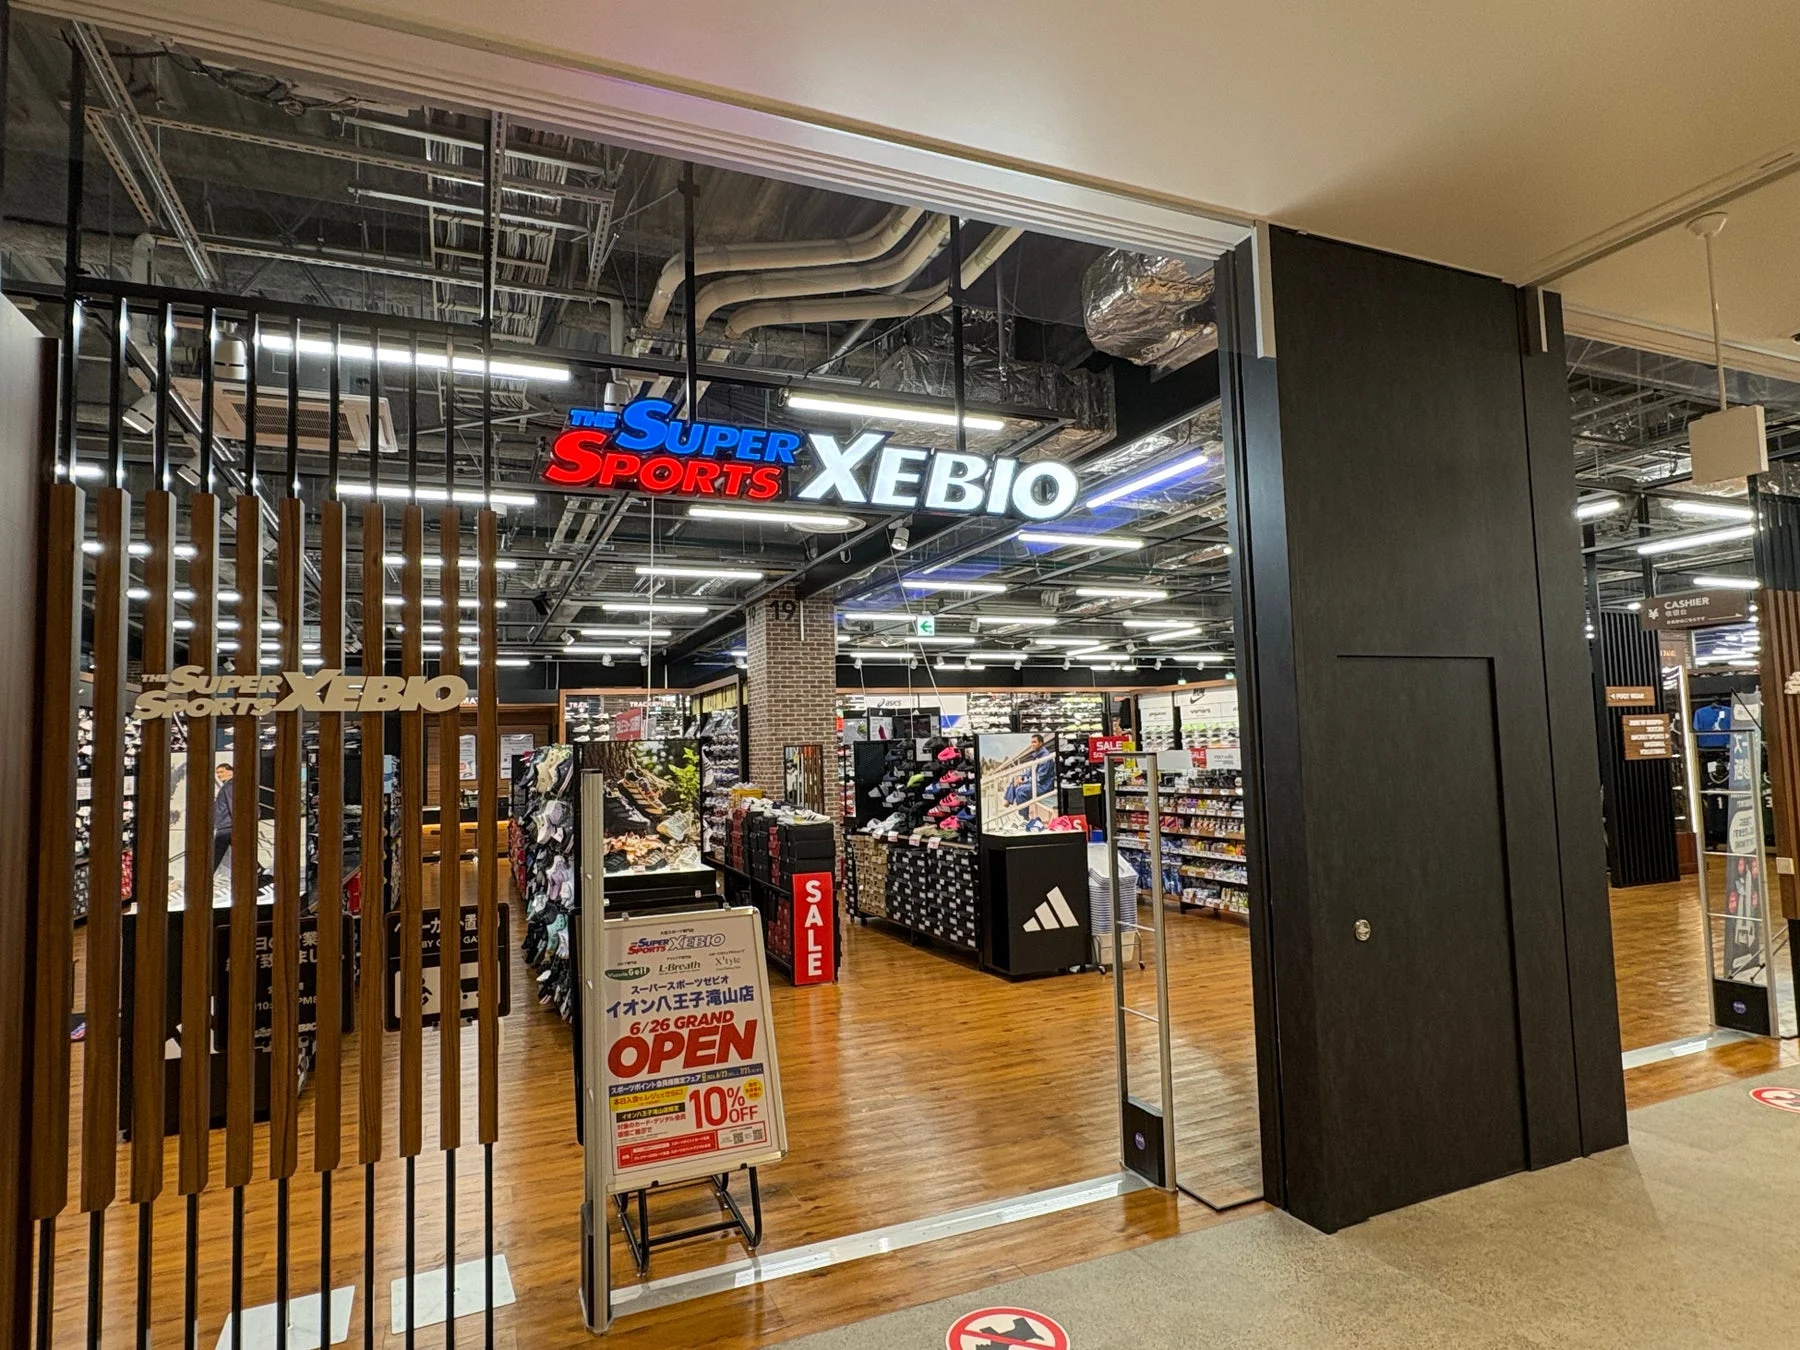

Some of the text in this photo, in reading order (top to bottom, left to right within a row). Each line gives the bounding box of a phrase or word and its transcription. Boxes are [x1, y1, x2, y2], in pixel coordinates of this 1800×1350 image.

[569, 398, 800, 465] THE SUPER
[543, 429, 782, 500] SPORTS
[796, 430, 1079, 521] XEBIO
[769, 600, 796, 621] 19
[1664, 597, 1710, 610] CASHIER
[141, 665, 284, 694] THE SUPER
[272, 668, 468, 712] XEBIO
[133, 689, 277, 720] SPORTS
[1096, 741, 1123, 751] SALE
[804, 879, 823, 976] SALE
[627, 945, 666, 955] SPORTS
[638, 937, 670, 947] SUPER
[668, 933, 726, 951] XEBIO
[631, 975, 729, 995] スーパースポーツゼビオ
[606, 985, 754, 1018] イオン八王子滝山店
[630, 1010, 734, 1035] 6/26 GRAND
[608, 1019, 758, 1078] OPEN
[728, 1105, 758, 1123] OFF
